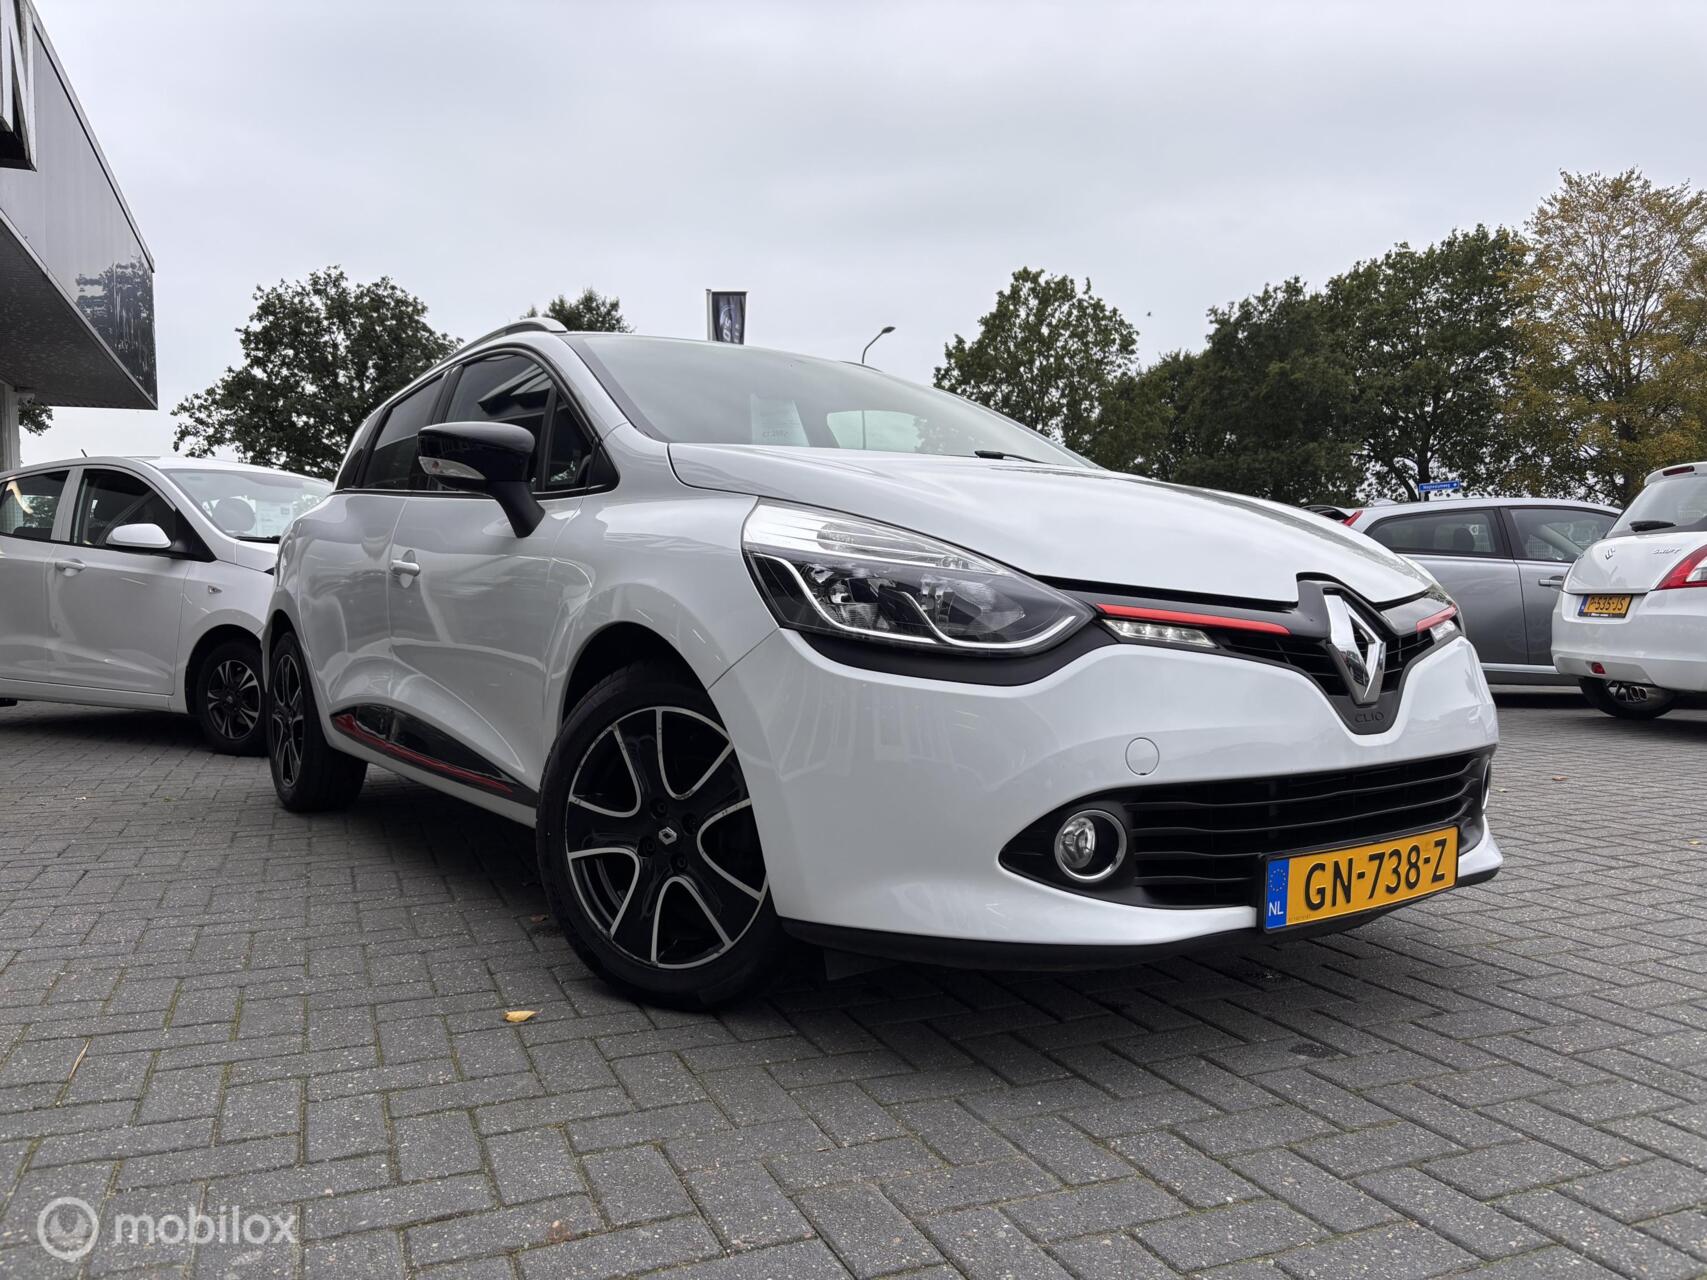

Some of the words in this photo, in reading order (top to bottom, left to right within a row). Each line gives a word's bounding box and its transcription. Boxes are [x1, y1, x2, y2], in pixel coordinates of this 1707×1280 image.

[1355, 711, 1385, 723] CLIO
[1304, 838, 1448, 911] GN-738-Z
[1268, 901, 1284, 917] NL
